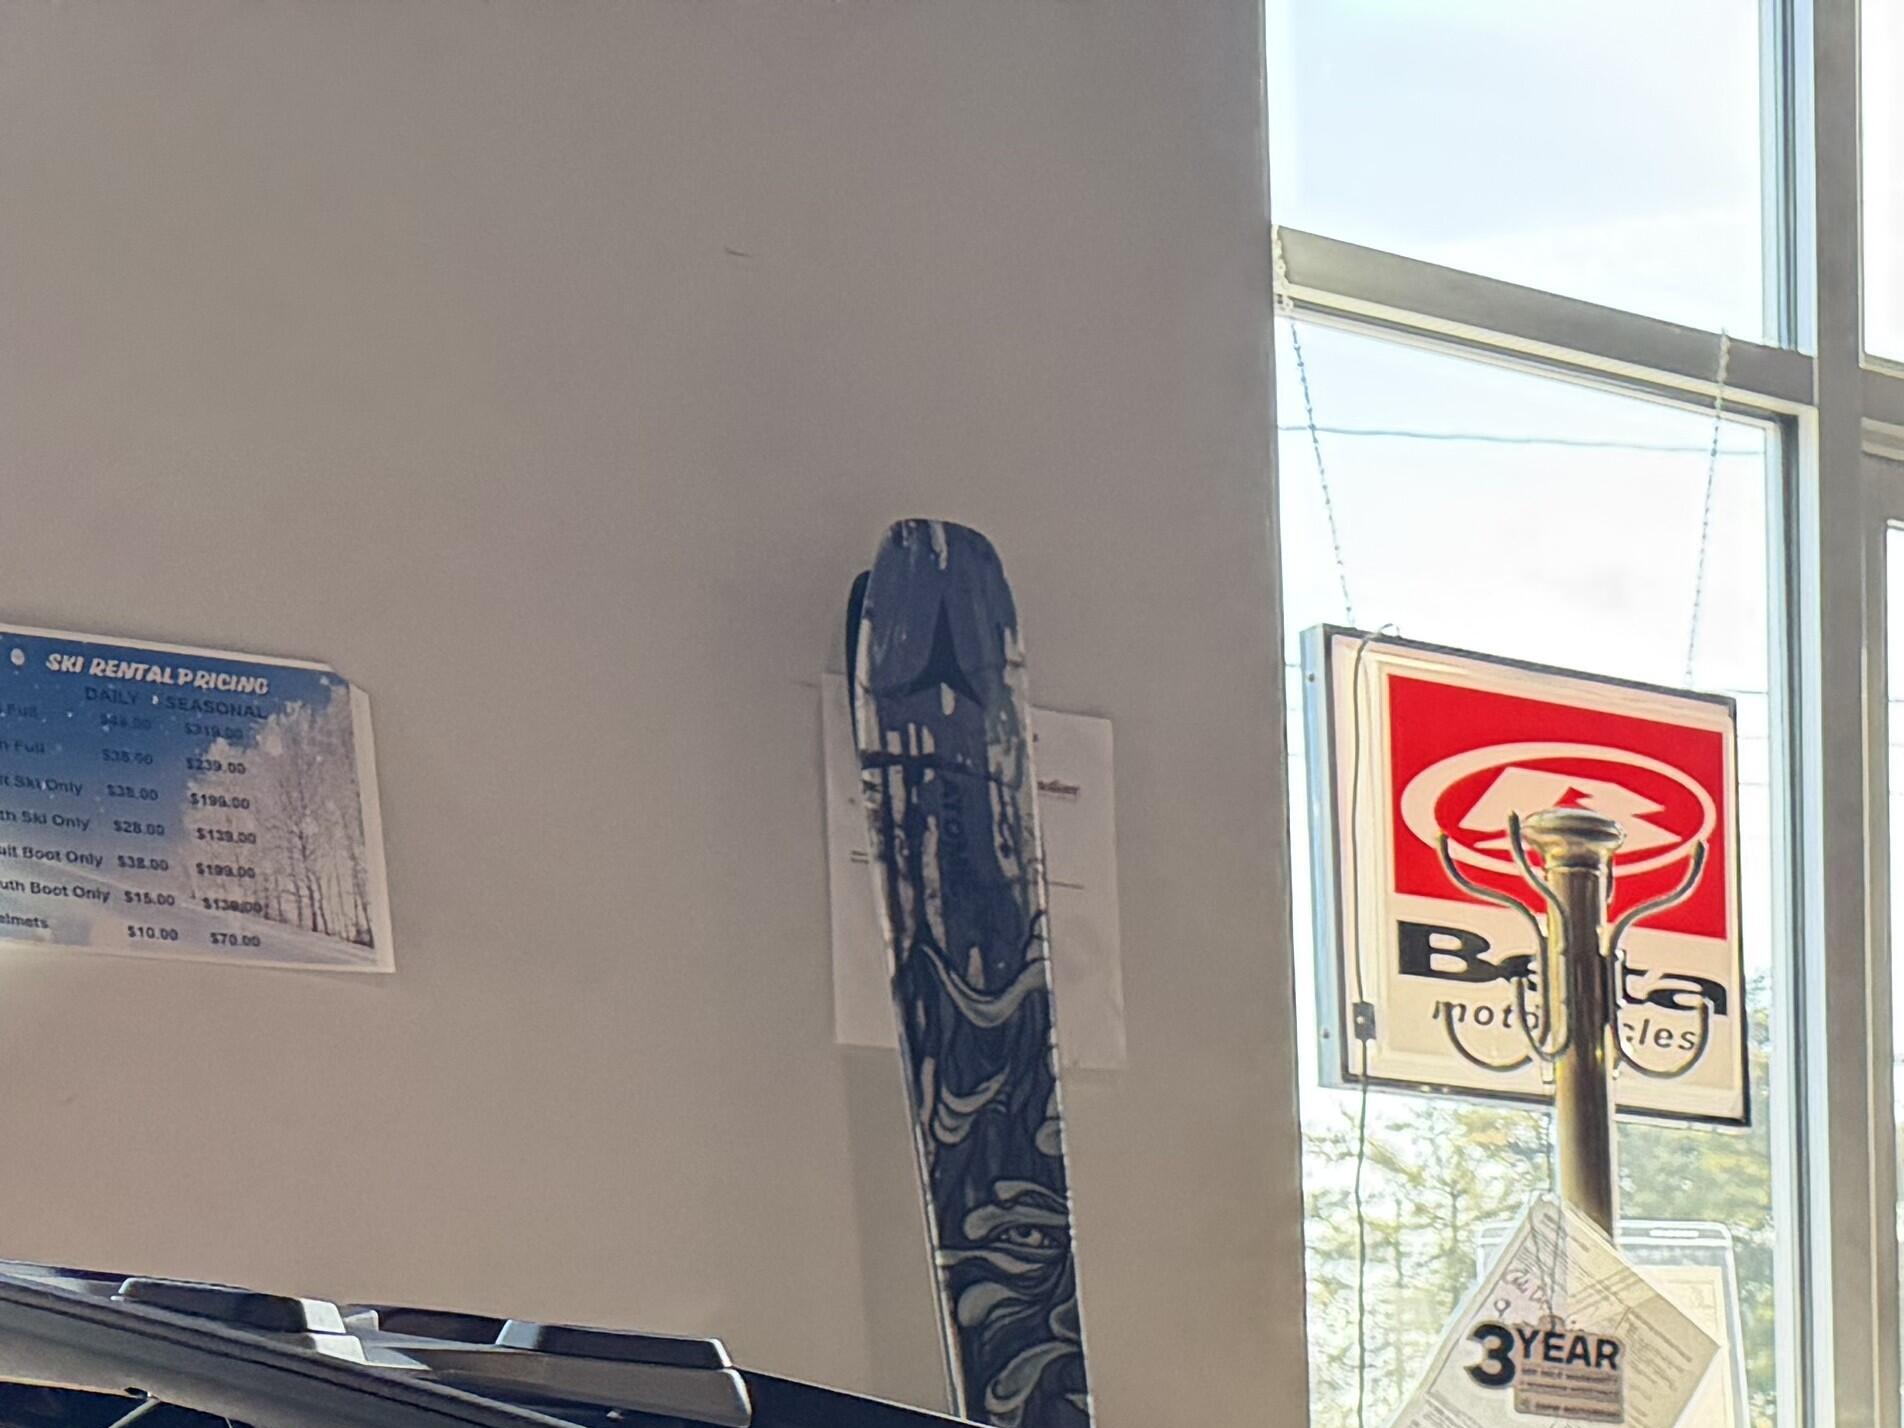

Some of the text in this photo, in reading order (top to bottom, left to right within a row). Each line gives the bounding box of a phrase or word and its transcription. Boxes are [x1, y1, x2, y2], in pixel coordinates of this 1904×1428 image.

[46, 653, 269, 695] SKI RENTAL PRICING
[85, 687, 268, 719] DAILY SEASONAL
[22, 809, 48, 825] Ski
[52, 813, 90, 832] Only
[23, 846, 61, 863] Boot
[65, 849, 104, 869] Only
[30, 880, 68, 898] Boot
[72, 884, 111, 904] Only
[0, 913, 49, 930] elmets
[1468, 1323, 1516, 1388] 3
[1516, 1327, 1620, 1371] YEAR
